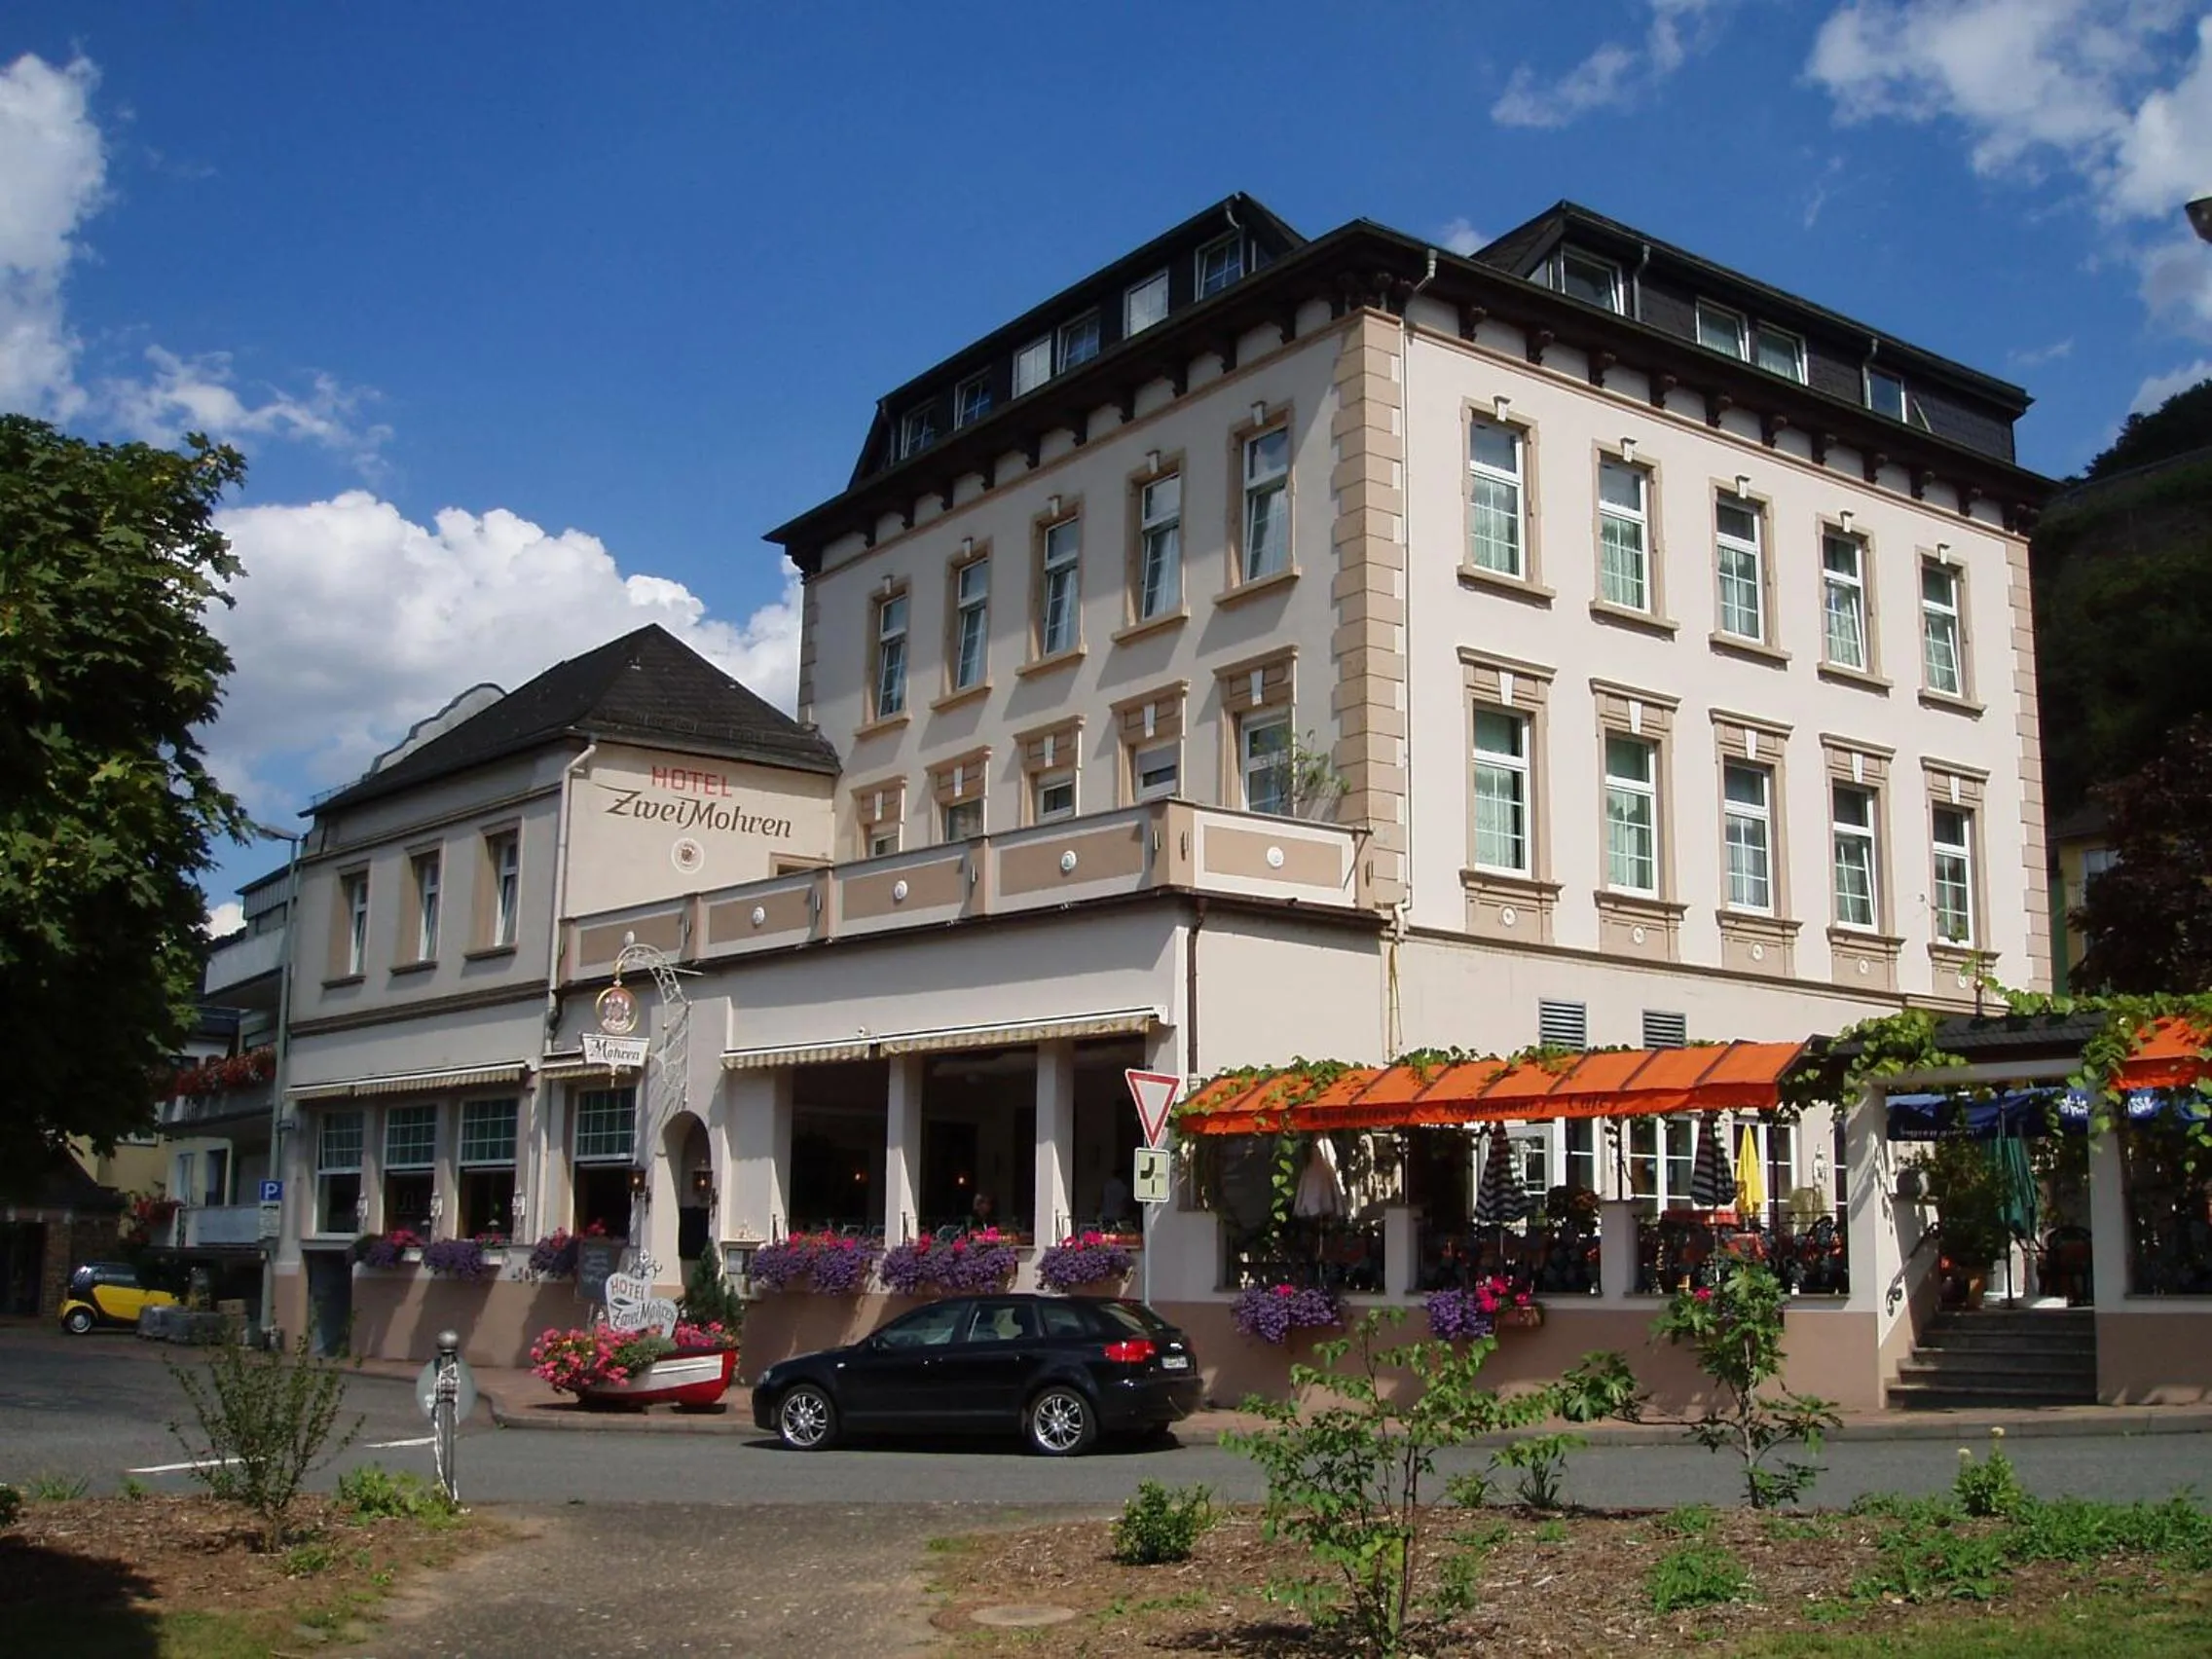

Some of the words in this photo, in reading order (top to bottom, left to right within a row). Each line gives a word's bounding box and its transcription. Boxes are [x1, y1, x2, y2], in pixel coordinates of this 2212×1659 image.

[651, 765, 732, 796] HOTEL
[265, 1182, 278, 1199] P
[610, 1276, 645, 1300] HOTEL
